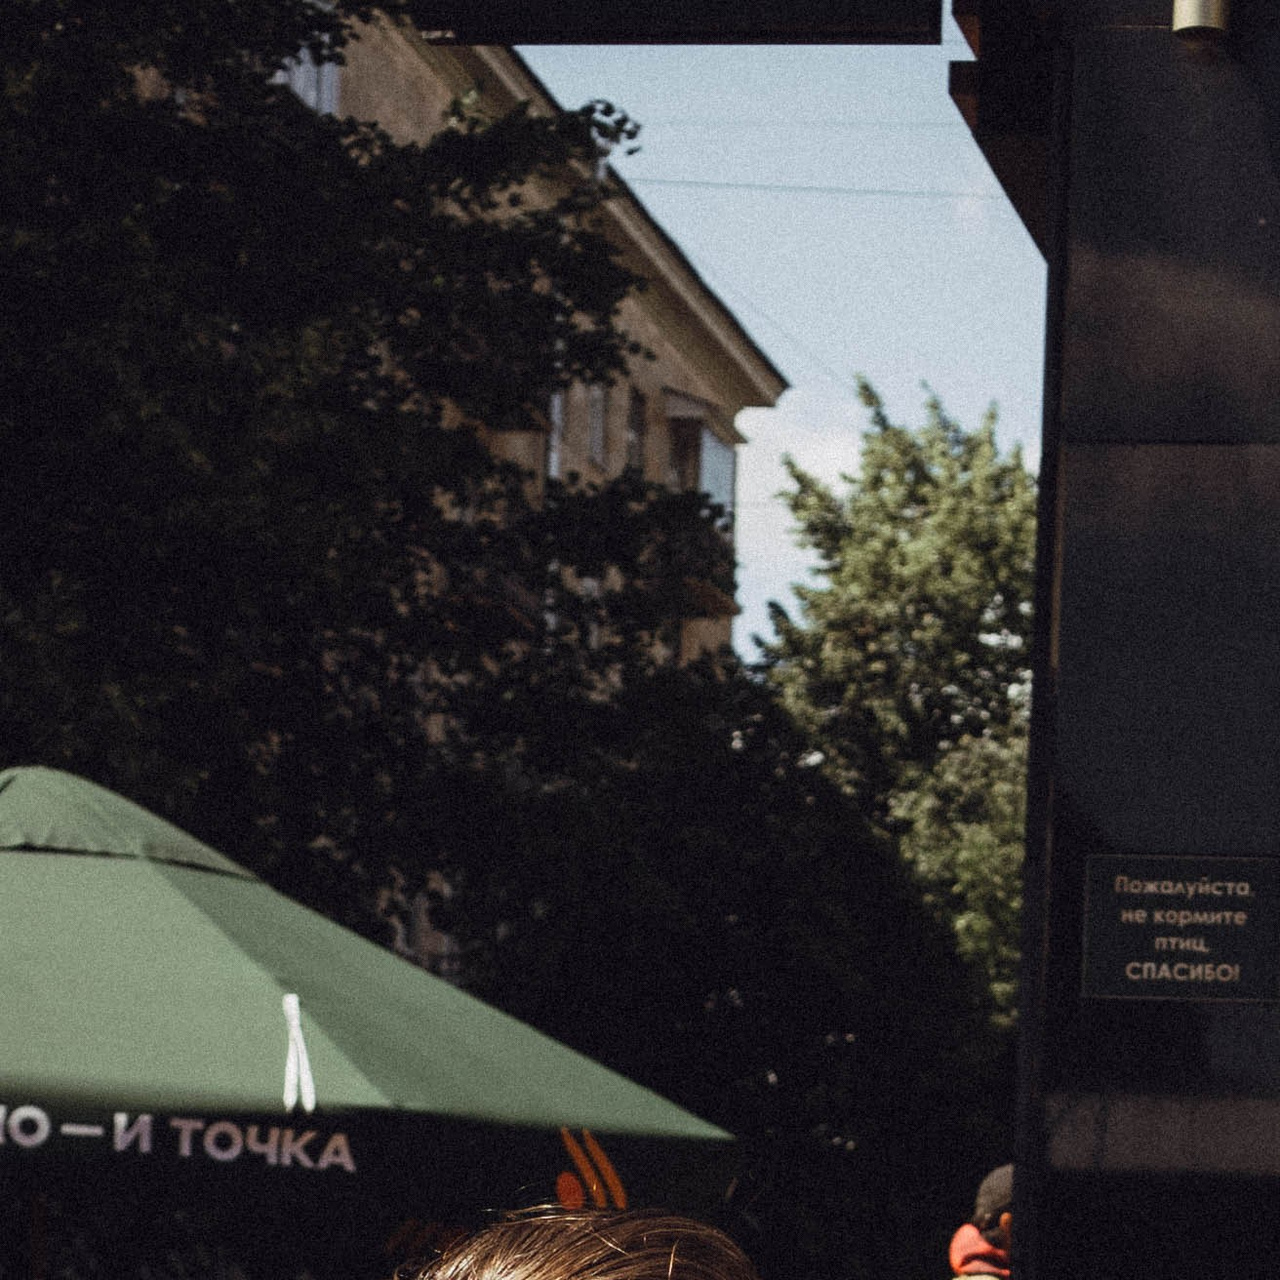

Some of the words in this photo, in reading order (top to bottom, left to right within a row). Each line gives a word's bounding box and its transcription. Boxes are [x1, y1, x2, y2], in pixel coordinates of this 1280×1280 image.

[1121, 909, 1147, 924] не
[1154, 909, 1248, 928] кормите
[1125, 961, 1241, 981] СПАСИБО!
[0, 1104, 50, 1148] О
[113, 1111, 153, 1153] И
[169, 1117, 356, 1173] ТОЧКА
